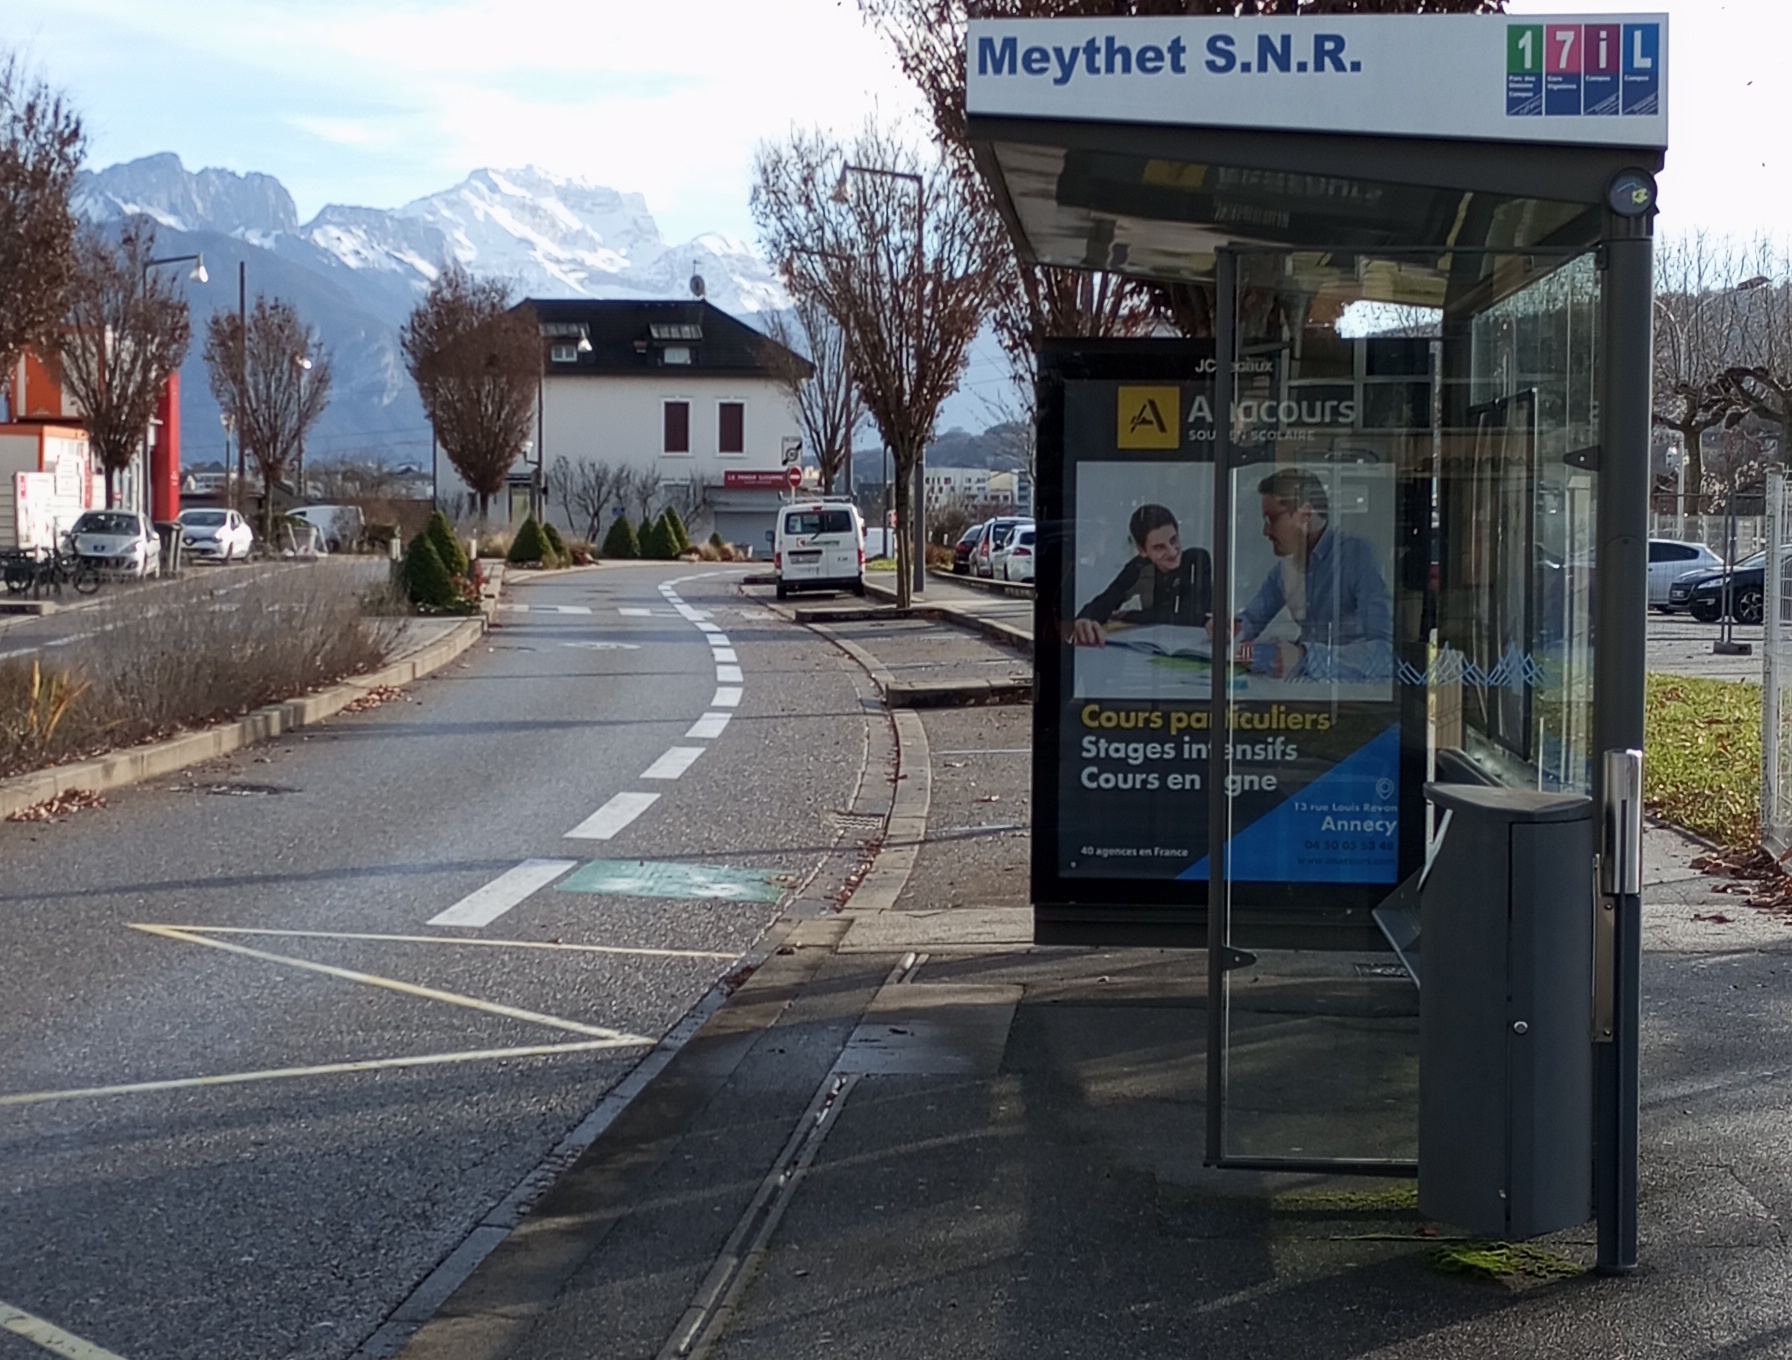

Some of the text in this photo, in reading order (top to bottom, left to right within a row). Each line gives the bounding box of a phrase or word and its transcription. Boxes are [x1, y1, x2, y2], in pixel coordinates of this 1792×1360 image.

[978, 33, 1362, 86] Meythet S.N.R.
[1518, 30, 1652, 69] 1 7 i L
[1081, 704, 1163, 730] Cours
[1081, 735, 1176, 765] Stages
[1080, 767, 1278, 796] Cours en gne
[1310, 803, 1329, 812] rue
[1332, 802, 1360, 812] Louis
[1321, 815, 1398, 837] Annecy
[1081, 846, 1189, 858] 40 agences en France
